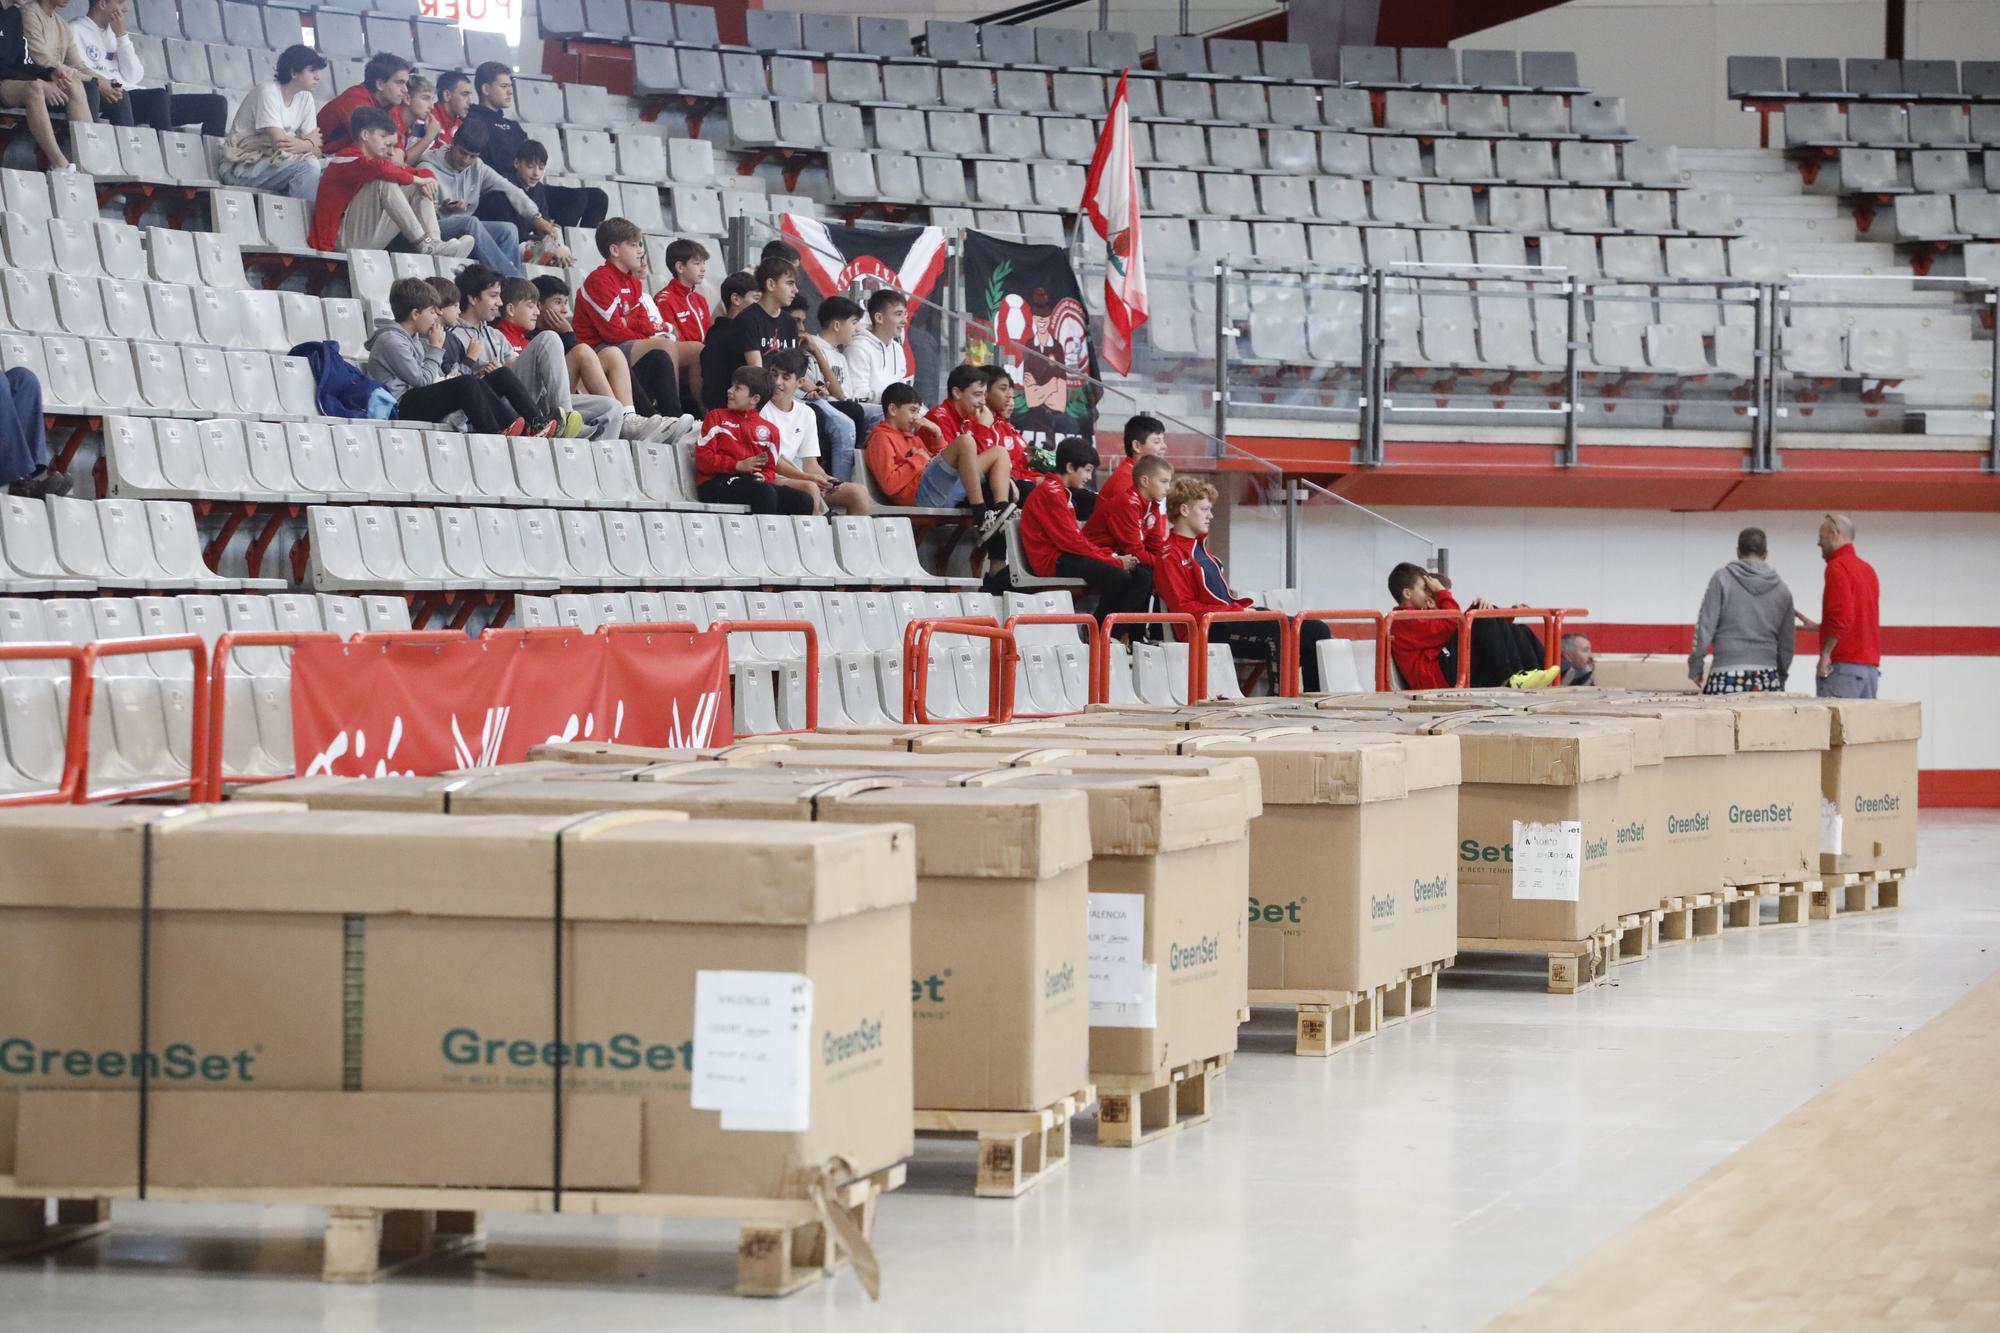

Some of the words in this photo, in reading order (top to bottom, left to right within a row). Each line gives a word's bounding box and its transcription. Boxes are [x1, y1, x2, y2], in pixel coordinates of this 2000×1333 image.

[1728, 803, 1793, 824] GreenSet
[1855, 793, 1900, 814] GreenSet
[1667, 812, 1710, 834] GreenSet
[1413, 875, 1447, 902] GreenSet
[1371, 893, 1395, 919] GreenSet
[1169, 935, 1218, 972] GreenSet
[442, 1028, 693, 1073] GreenSet
[824, 1017, 882, 1066] GreenSet
[0, 1037, 255, 1082] GreenSet
